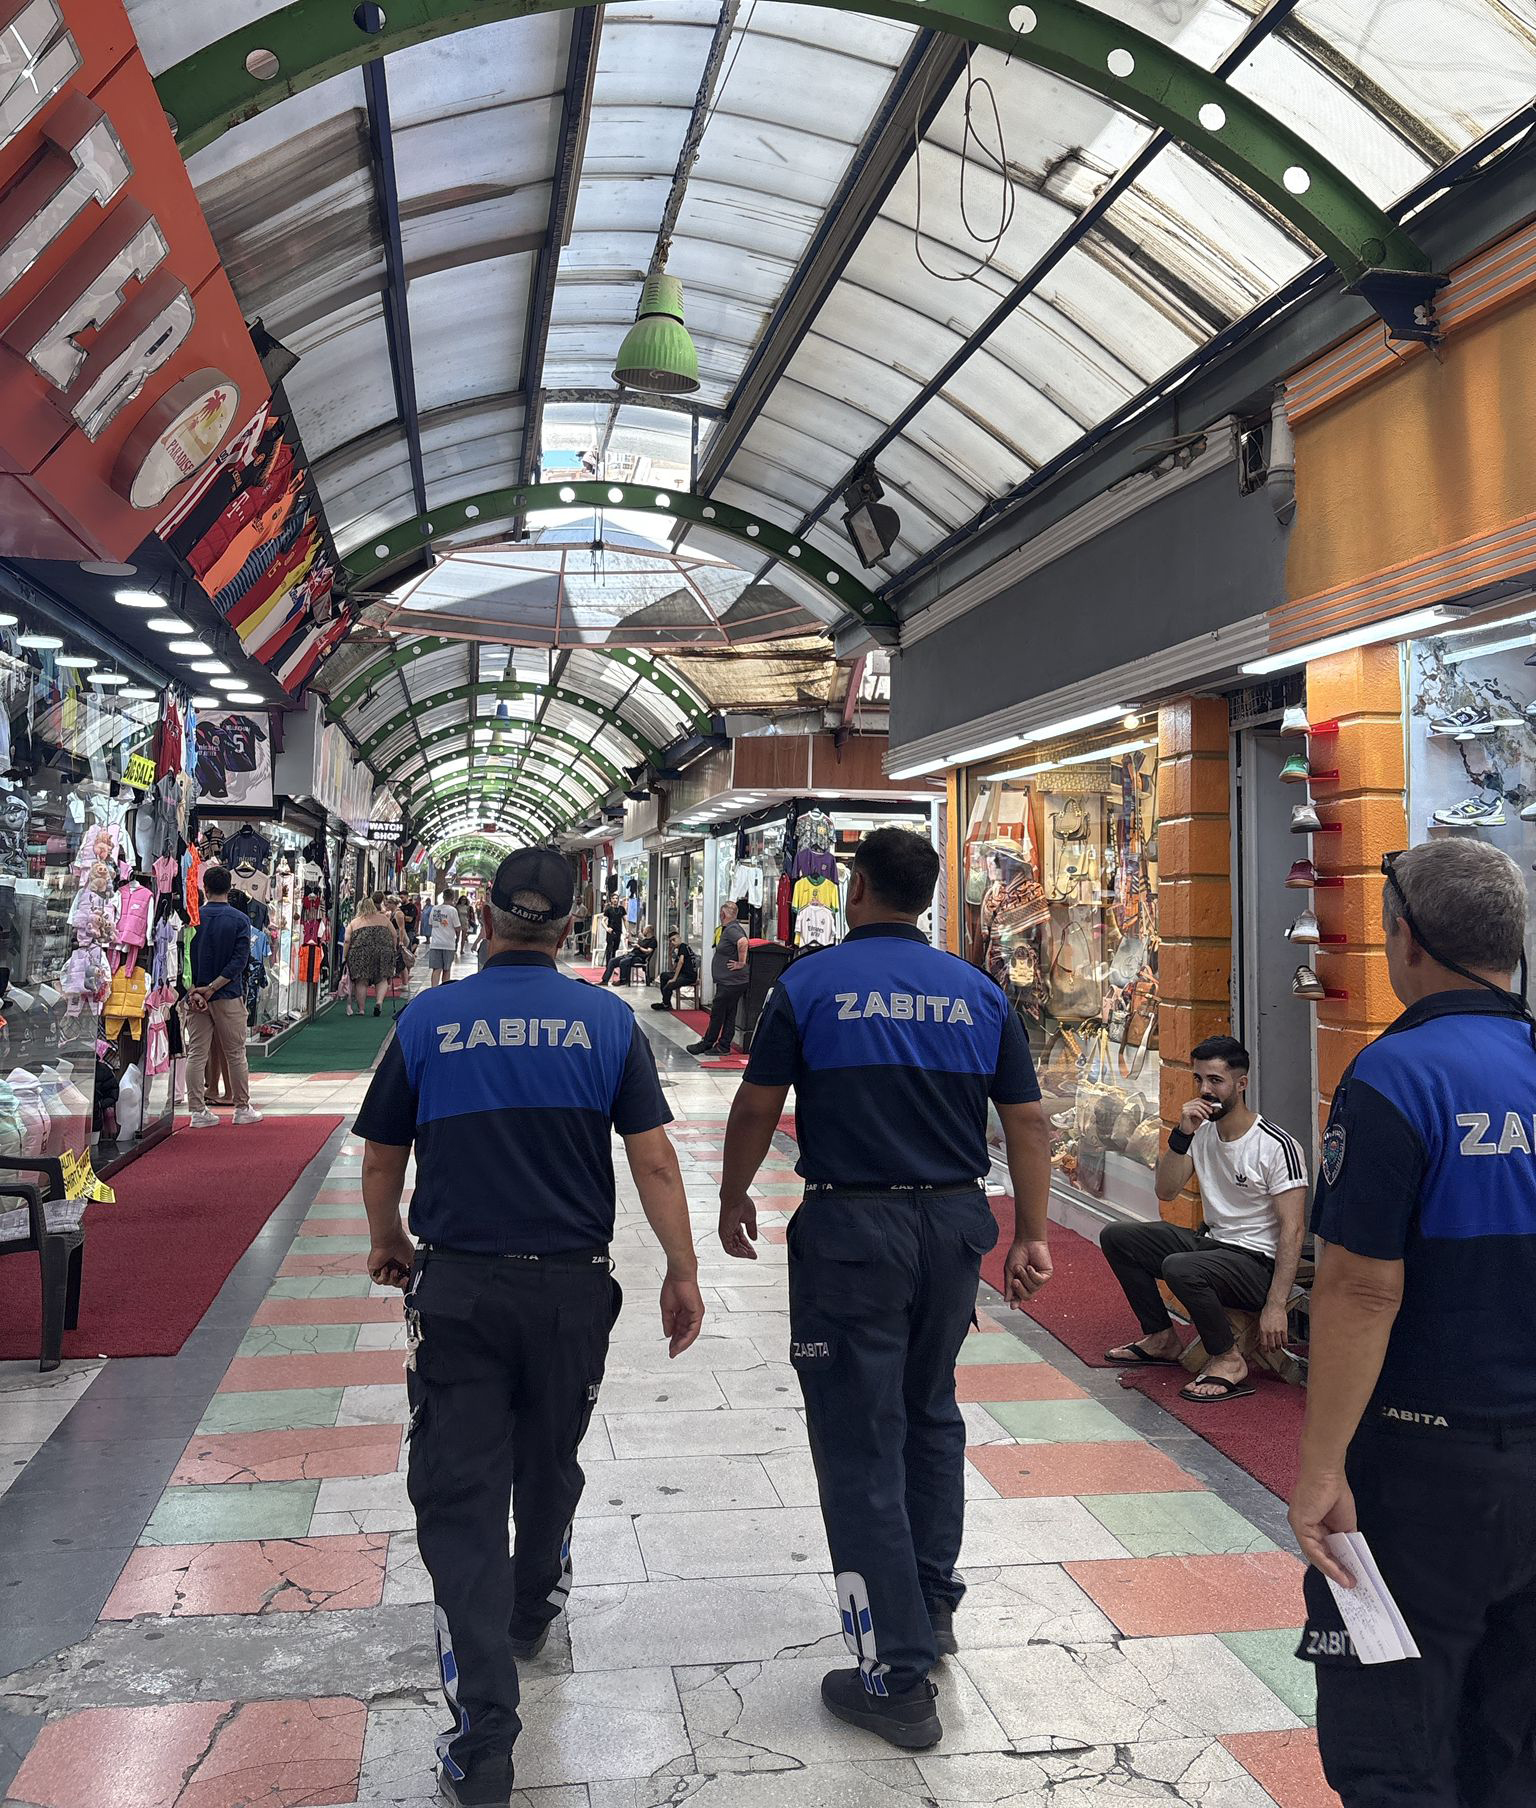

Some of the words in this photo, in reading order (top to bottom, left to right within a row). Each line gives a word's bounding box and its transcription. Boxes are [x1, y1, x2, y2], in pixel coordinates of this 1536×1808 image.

[166, 438, 195, 476] PARADISE
[233, 734, 244, 753] 5
[133, 761, 154, 786] SALE
[369, 822, 404, 832] WATCH
[373, 831, 401, 841] SHOP
[511, 906, 544, 922] ZABITA
[835, 991, 974, 1026] ZABITA
[436, 1018, 592, 1053] ZABITA
[1455, 1111, 1536, 1154] ZA
[805, 1183, 833, 1191] ZABTA
[793, 1342, 830, 1358] ZABITA
